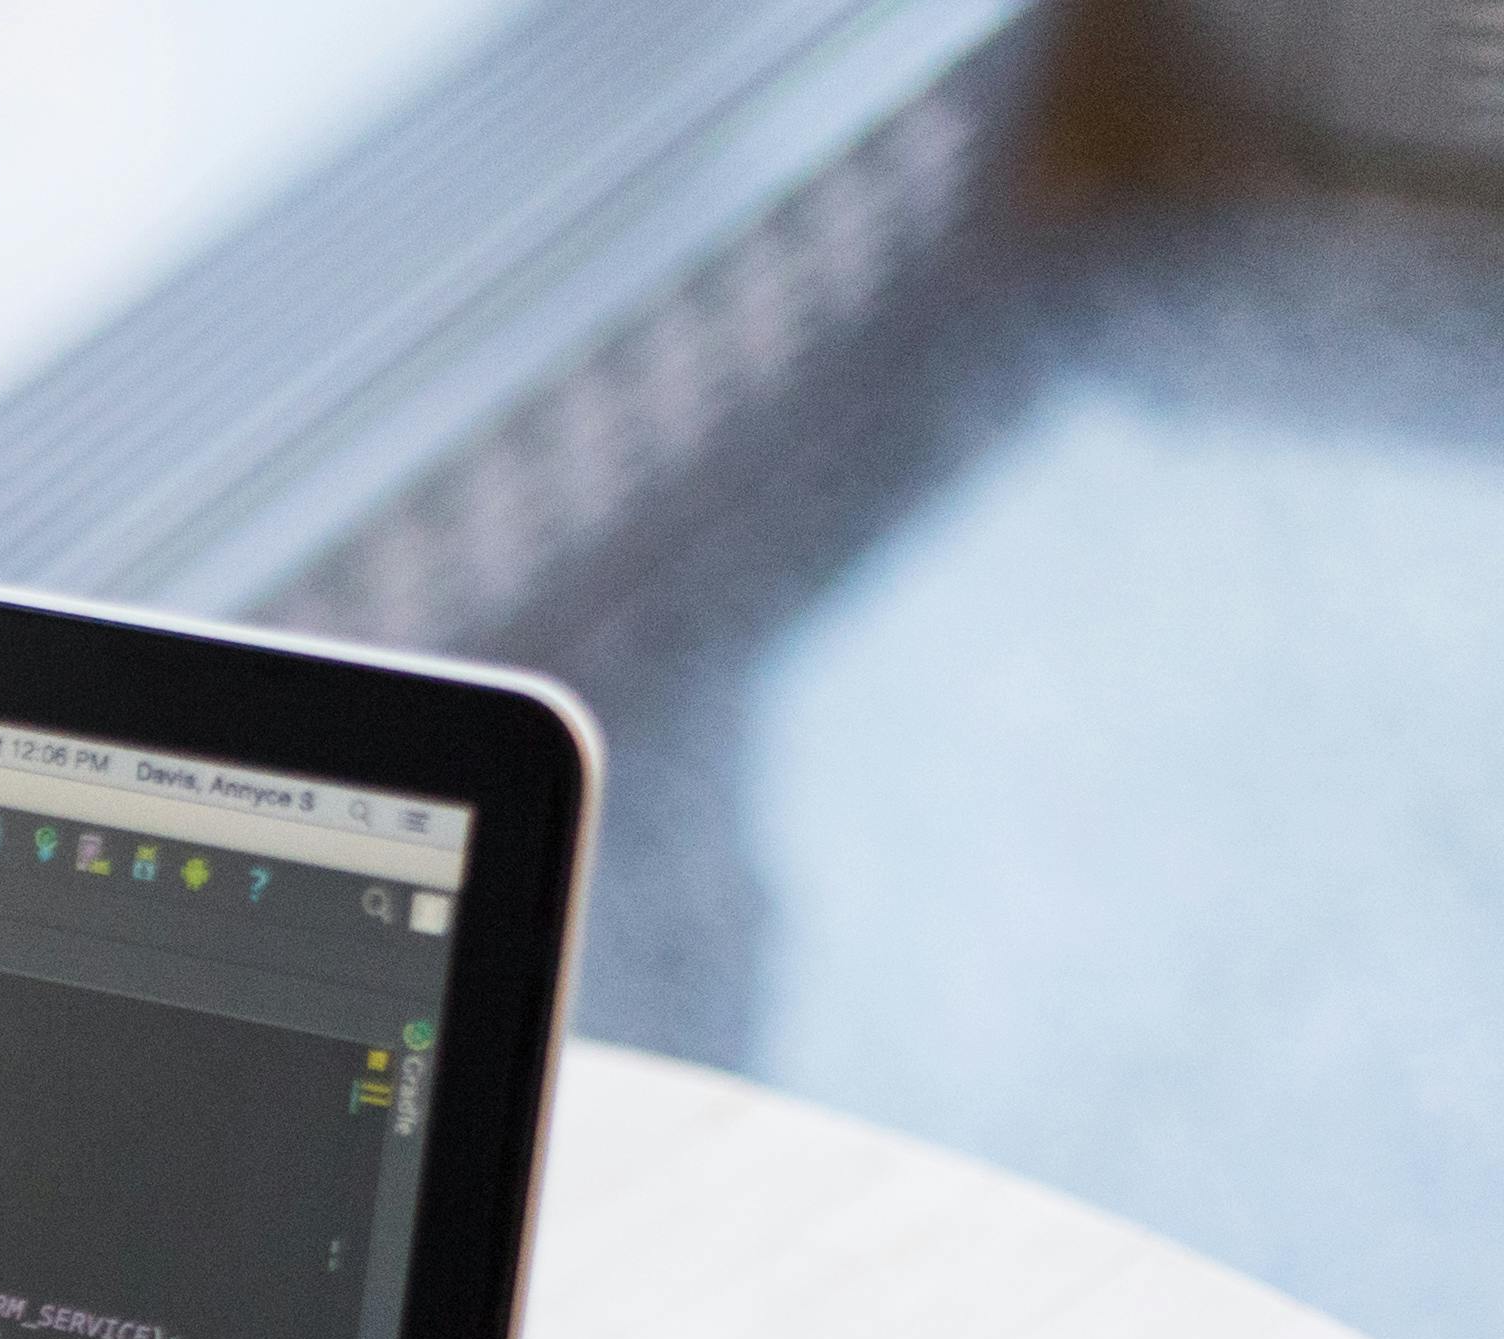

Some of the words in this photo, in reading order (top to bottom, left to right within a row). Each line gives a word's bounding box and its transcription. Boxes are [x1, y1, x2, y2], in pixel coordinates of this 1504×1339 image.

[10, 738, 68, 766] 12:06
[74, 749, 110, 774] PM
[134, 760, 200, 794] Davis,
[208, 774, 292, 807] Annyce
[298, 790, 316, 811] S
